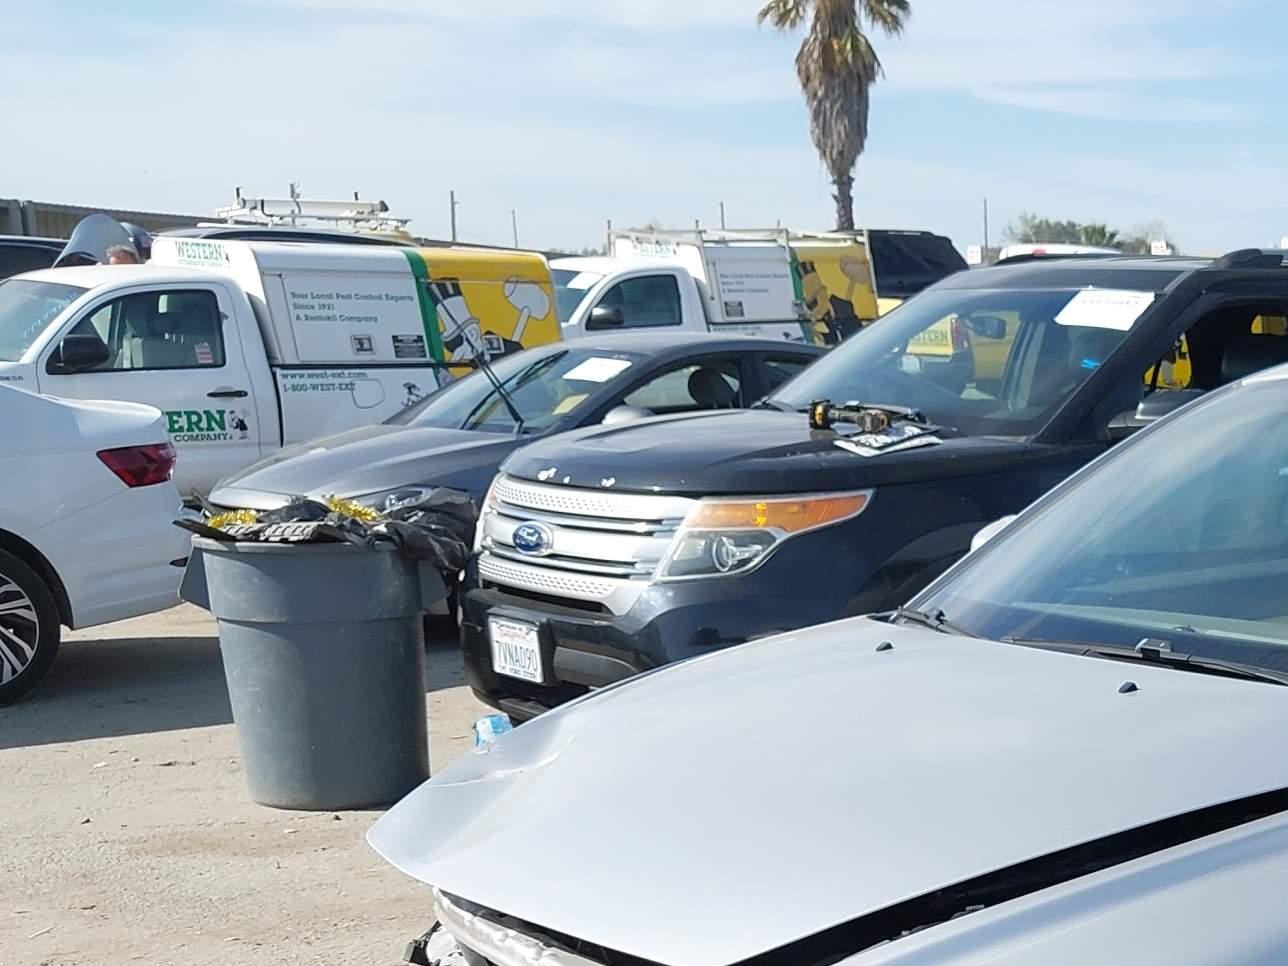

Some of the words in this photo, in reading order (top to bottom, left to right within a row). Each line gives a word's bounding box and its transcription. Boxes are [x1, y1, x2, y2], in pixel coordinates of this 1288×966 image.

[175, 241, 223, 261] WESTERN
[916, 330, 948, 342] STERN
[162, 410, 226, 433] ERN
[174, 433, 228, 442] COMPANY
